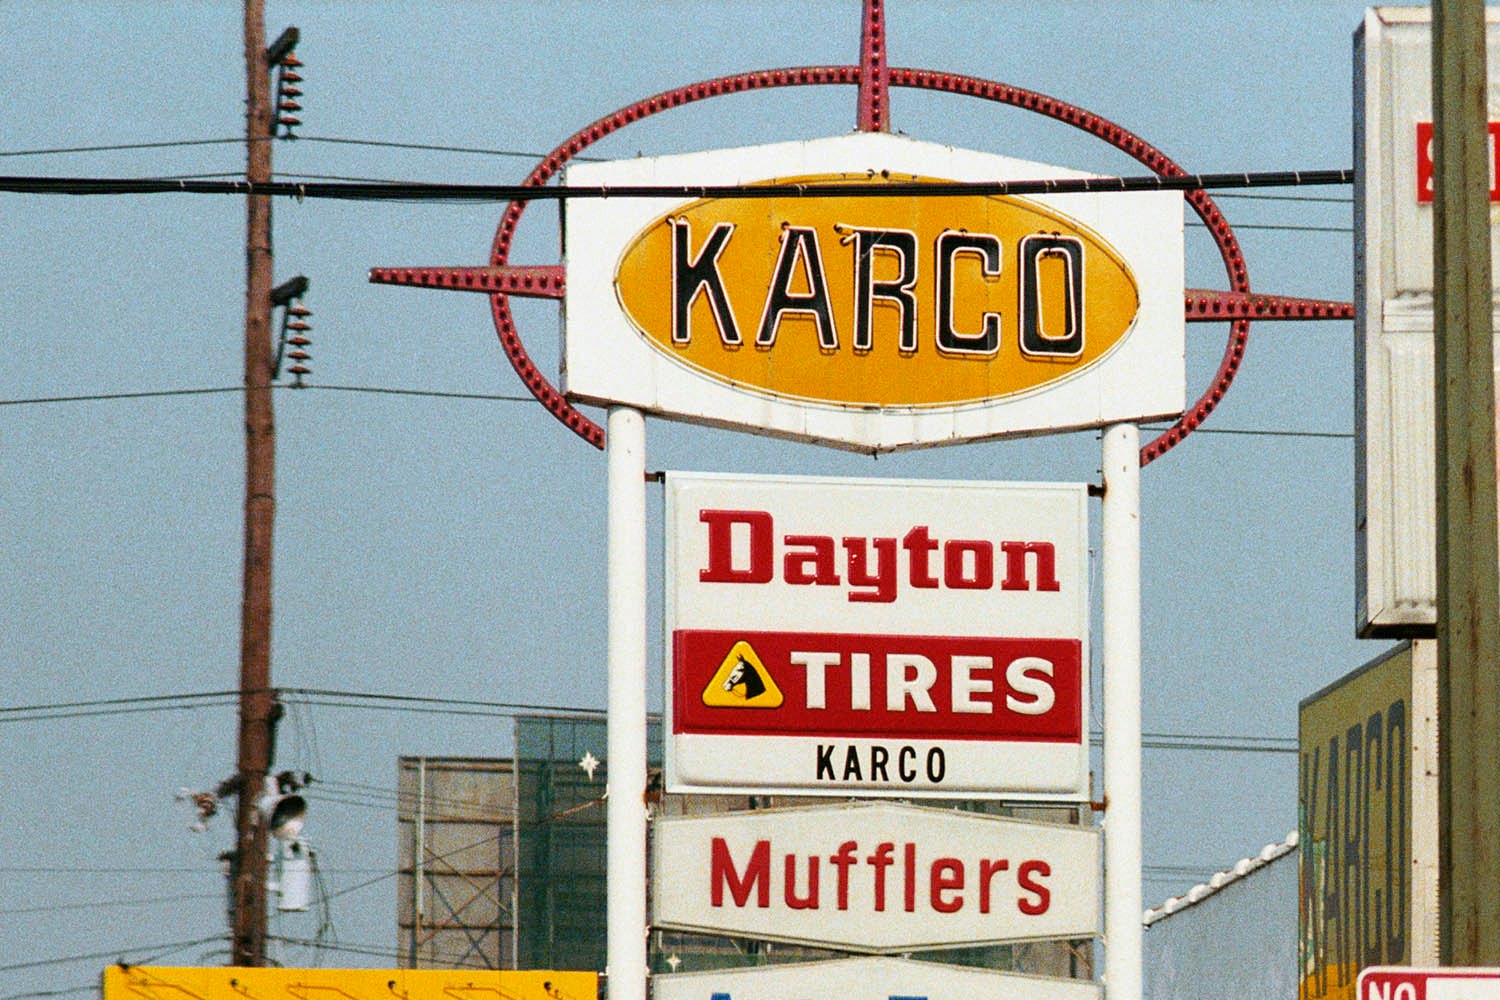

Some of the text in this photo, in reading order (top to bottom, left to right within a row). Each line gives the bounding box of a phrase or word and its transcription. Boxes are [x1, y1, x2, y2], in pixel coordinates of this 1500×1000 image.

[668, 217, 1086, 358] KARCO
[699, 509, 1060, 603] Dayton
[790, 651, 1056, 716] TIRES
[816, 744, 946, 783] KARCO
[711, 837, 1052, 915] Mufflers
